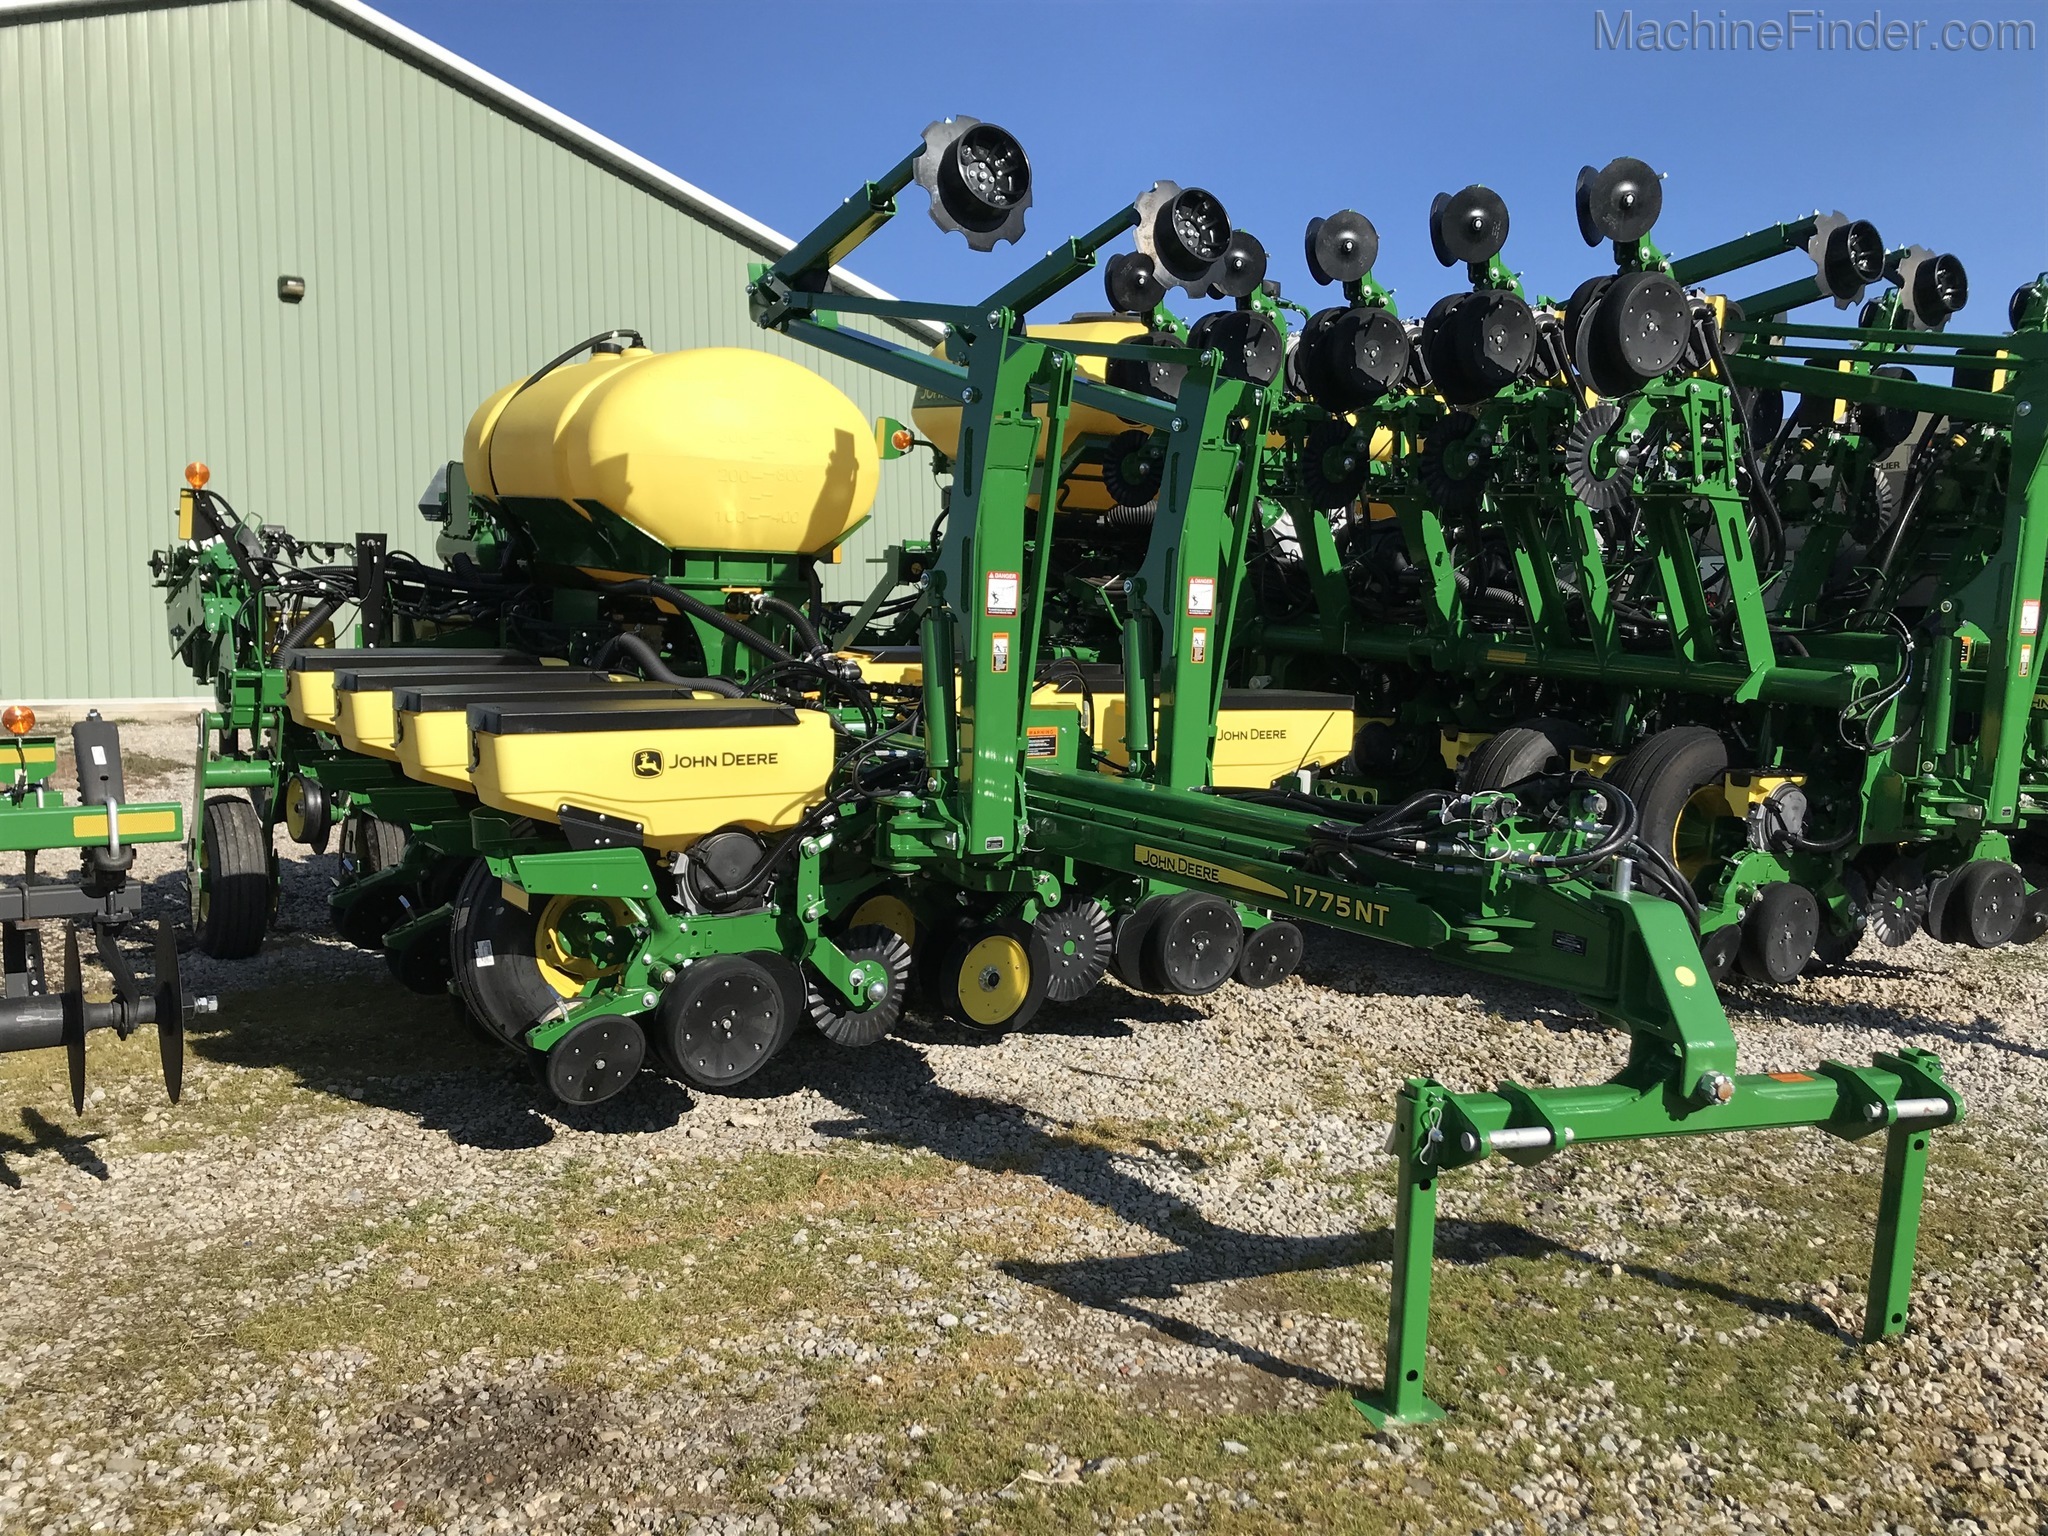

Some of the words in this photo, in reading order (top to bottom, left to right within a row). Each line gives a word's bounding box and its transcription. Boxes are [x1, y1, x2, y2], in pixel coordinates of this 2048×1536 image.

[994, 572, 1017, 580] DANGER
[1217, 729, 1248, 741] JOHN
[1250, 728, 1287, 740] DEERE
[669, 754, 717, 769] JOHN
[722, 752, 778, 766] DEERE
[1142, 850, 1176, 872] JOHN
[1178, 858, 1220, 882] DEERE
